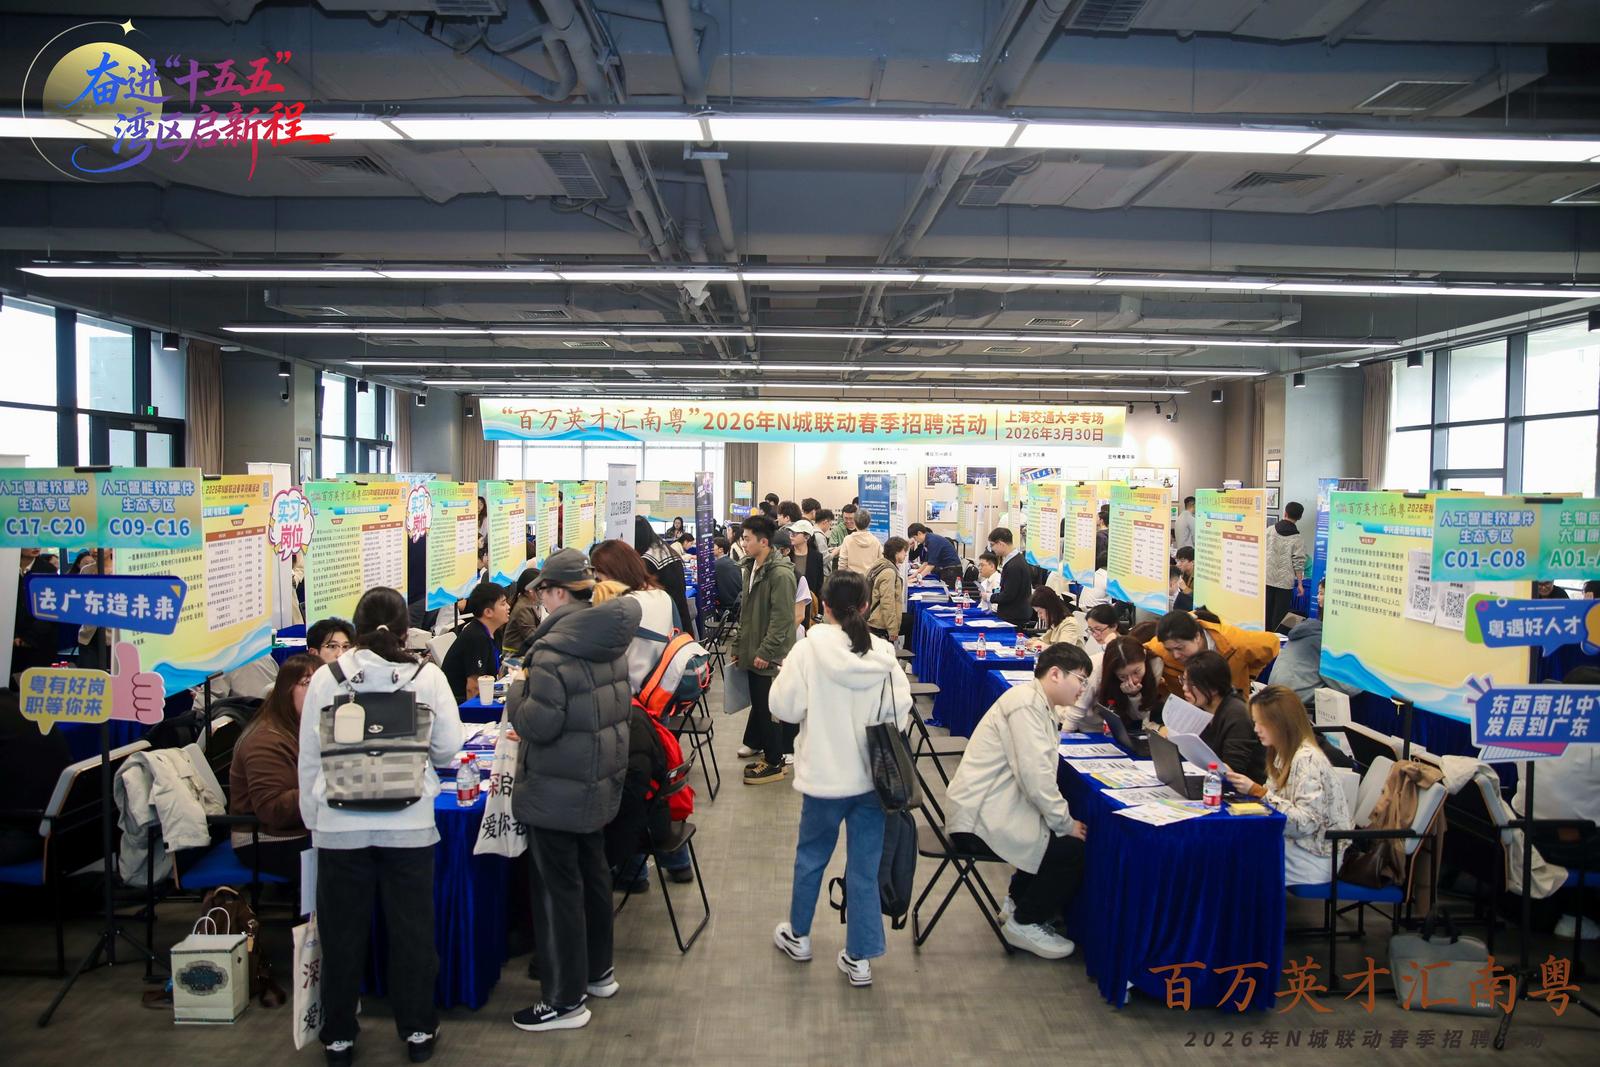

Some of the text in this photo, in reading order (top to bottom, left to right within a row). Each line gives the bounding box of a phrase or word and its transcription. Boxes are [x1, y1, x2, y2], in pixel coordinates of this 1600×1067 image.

[501, 406, 987, 436] “百万英才汇南粤”2026年N城联动春季招聘活动
[1004, 410, 1104, 425] 上海交通大学专场
[1005, 426, 1104, 442] 2026年3月30日
[0, 479, 89, 496] 人工智能软硬件
[101, 479, 195, 497] 人工智能软硬件
[18, 496, 71, 512] 生态专区
[122, 497, 175, 513] 生态专区
[278, 499, 300, 523] 实习
[7, 518, 86, 535] C17-C20
[109, 519, 190, 536] C09-C16
[1440, 511, 1535, 528] 人工智能软硬件
[281, 524, 303, 550] 岗位
[1459, 528, 1514, 546] 生态专区
[1444, 550, 1527, 568] C01-C08
[39, 588, 175, 621] 去广东造未来
[1488, 615, 1582, 639] 粤遇好人才
[28, 675, 105, 697] 粤有好岗
[25, 696, 104, 717] 职等你来
[1489, 694, 1594, 715] 东西南北中
[1484, 716, 1590, 737] 发展到广东
